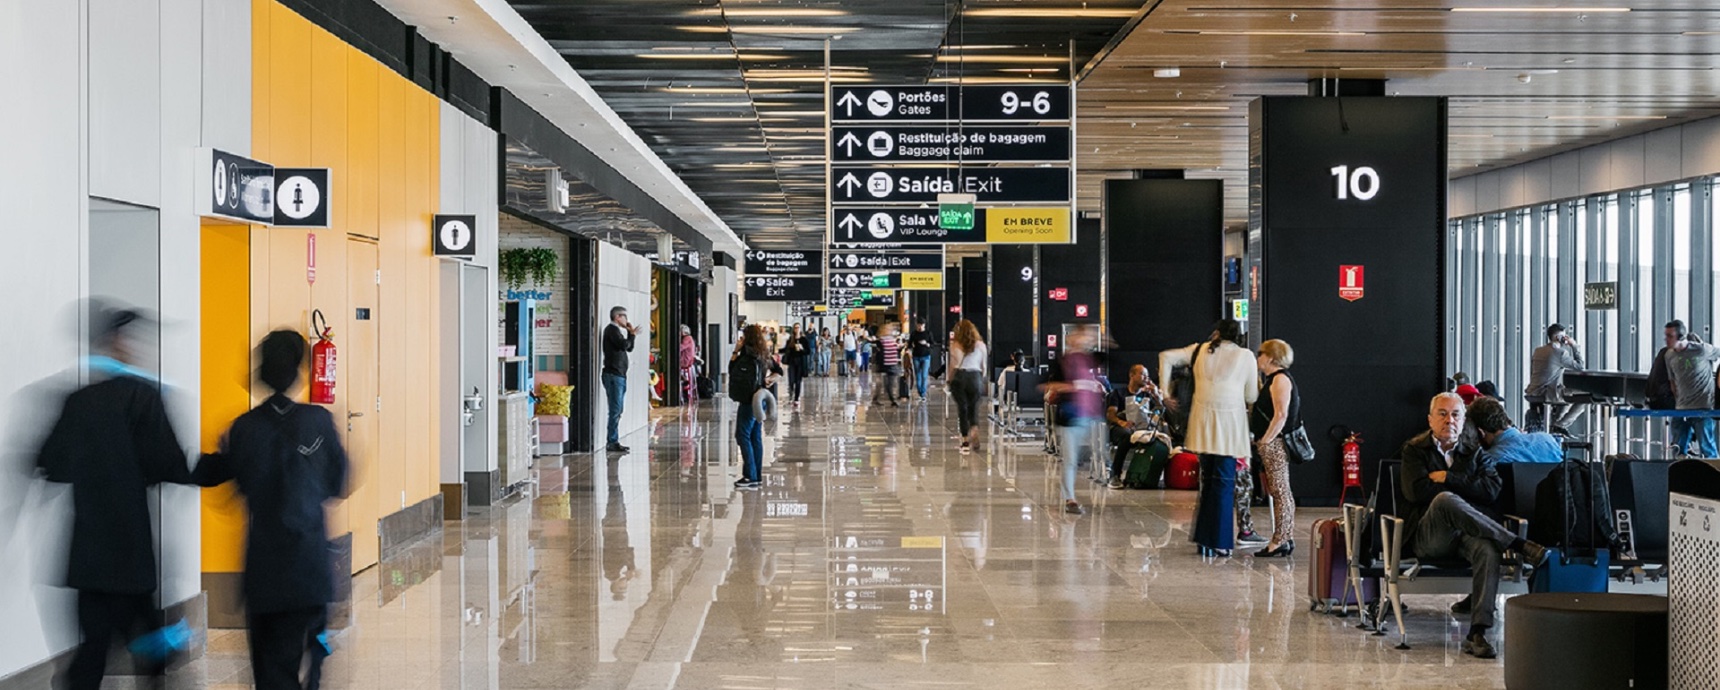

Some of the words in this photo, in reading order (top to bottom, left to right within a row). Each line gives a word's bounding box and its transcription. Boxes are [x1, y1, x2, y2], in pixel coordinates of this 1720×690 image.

[899, 91, 945, 102] Portões
[1001, 91, 1050, 114] 9-6
[898, 104, 931, 115] Gates
[898, 132, 967, 144] Restituição
[970, 132, 986, 143] de
[989, 132, 1046, 145] bagagem
[898, 145, 950, 157] Baggage
[953, 145, 984, 156] claim
[898, 175, 954, 193] Saída
[965, 176, 1003, 193] Exit
[1331, 165, 1380, 200] 10
[899, 214, 926, 226] Sala
[1003, 217, 1018, 226] EM
[1020, 217, 1053, 226] BREVE
[900, 228, 914, 236] VIP
[916, 228, 948, 237] Lounge
[1003, 227, 1033, 236] Opening
[1035, 227, 1053, 235] Soon
[860, 256, 887, 266] Saída
[892, 257, 910, 266] Exit
[1021, 266, 1033, 281] 9
[766, 277, 794, 287] Saída
[507, 288, 552, 300] better
[766, 287, 785, 297] Exit
